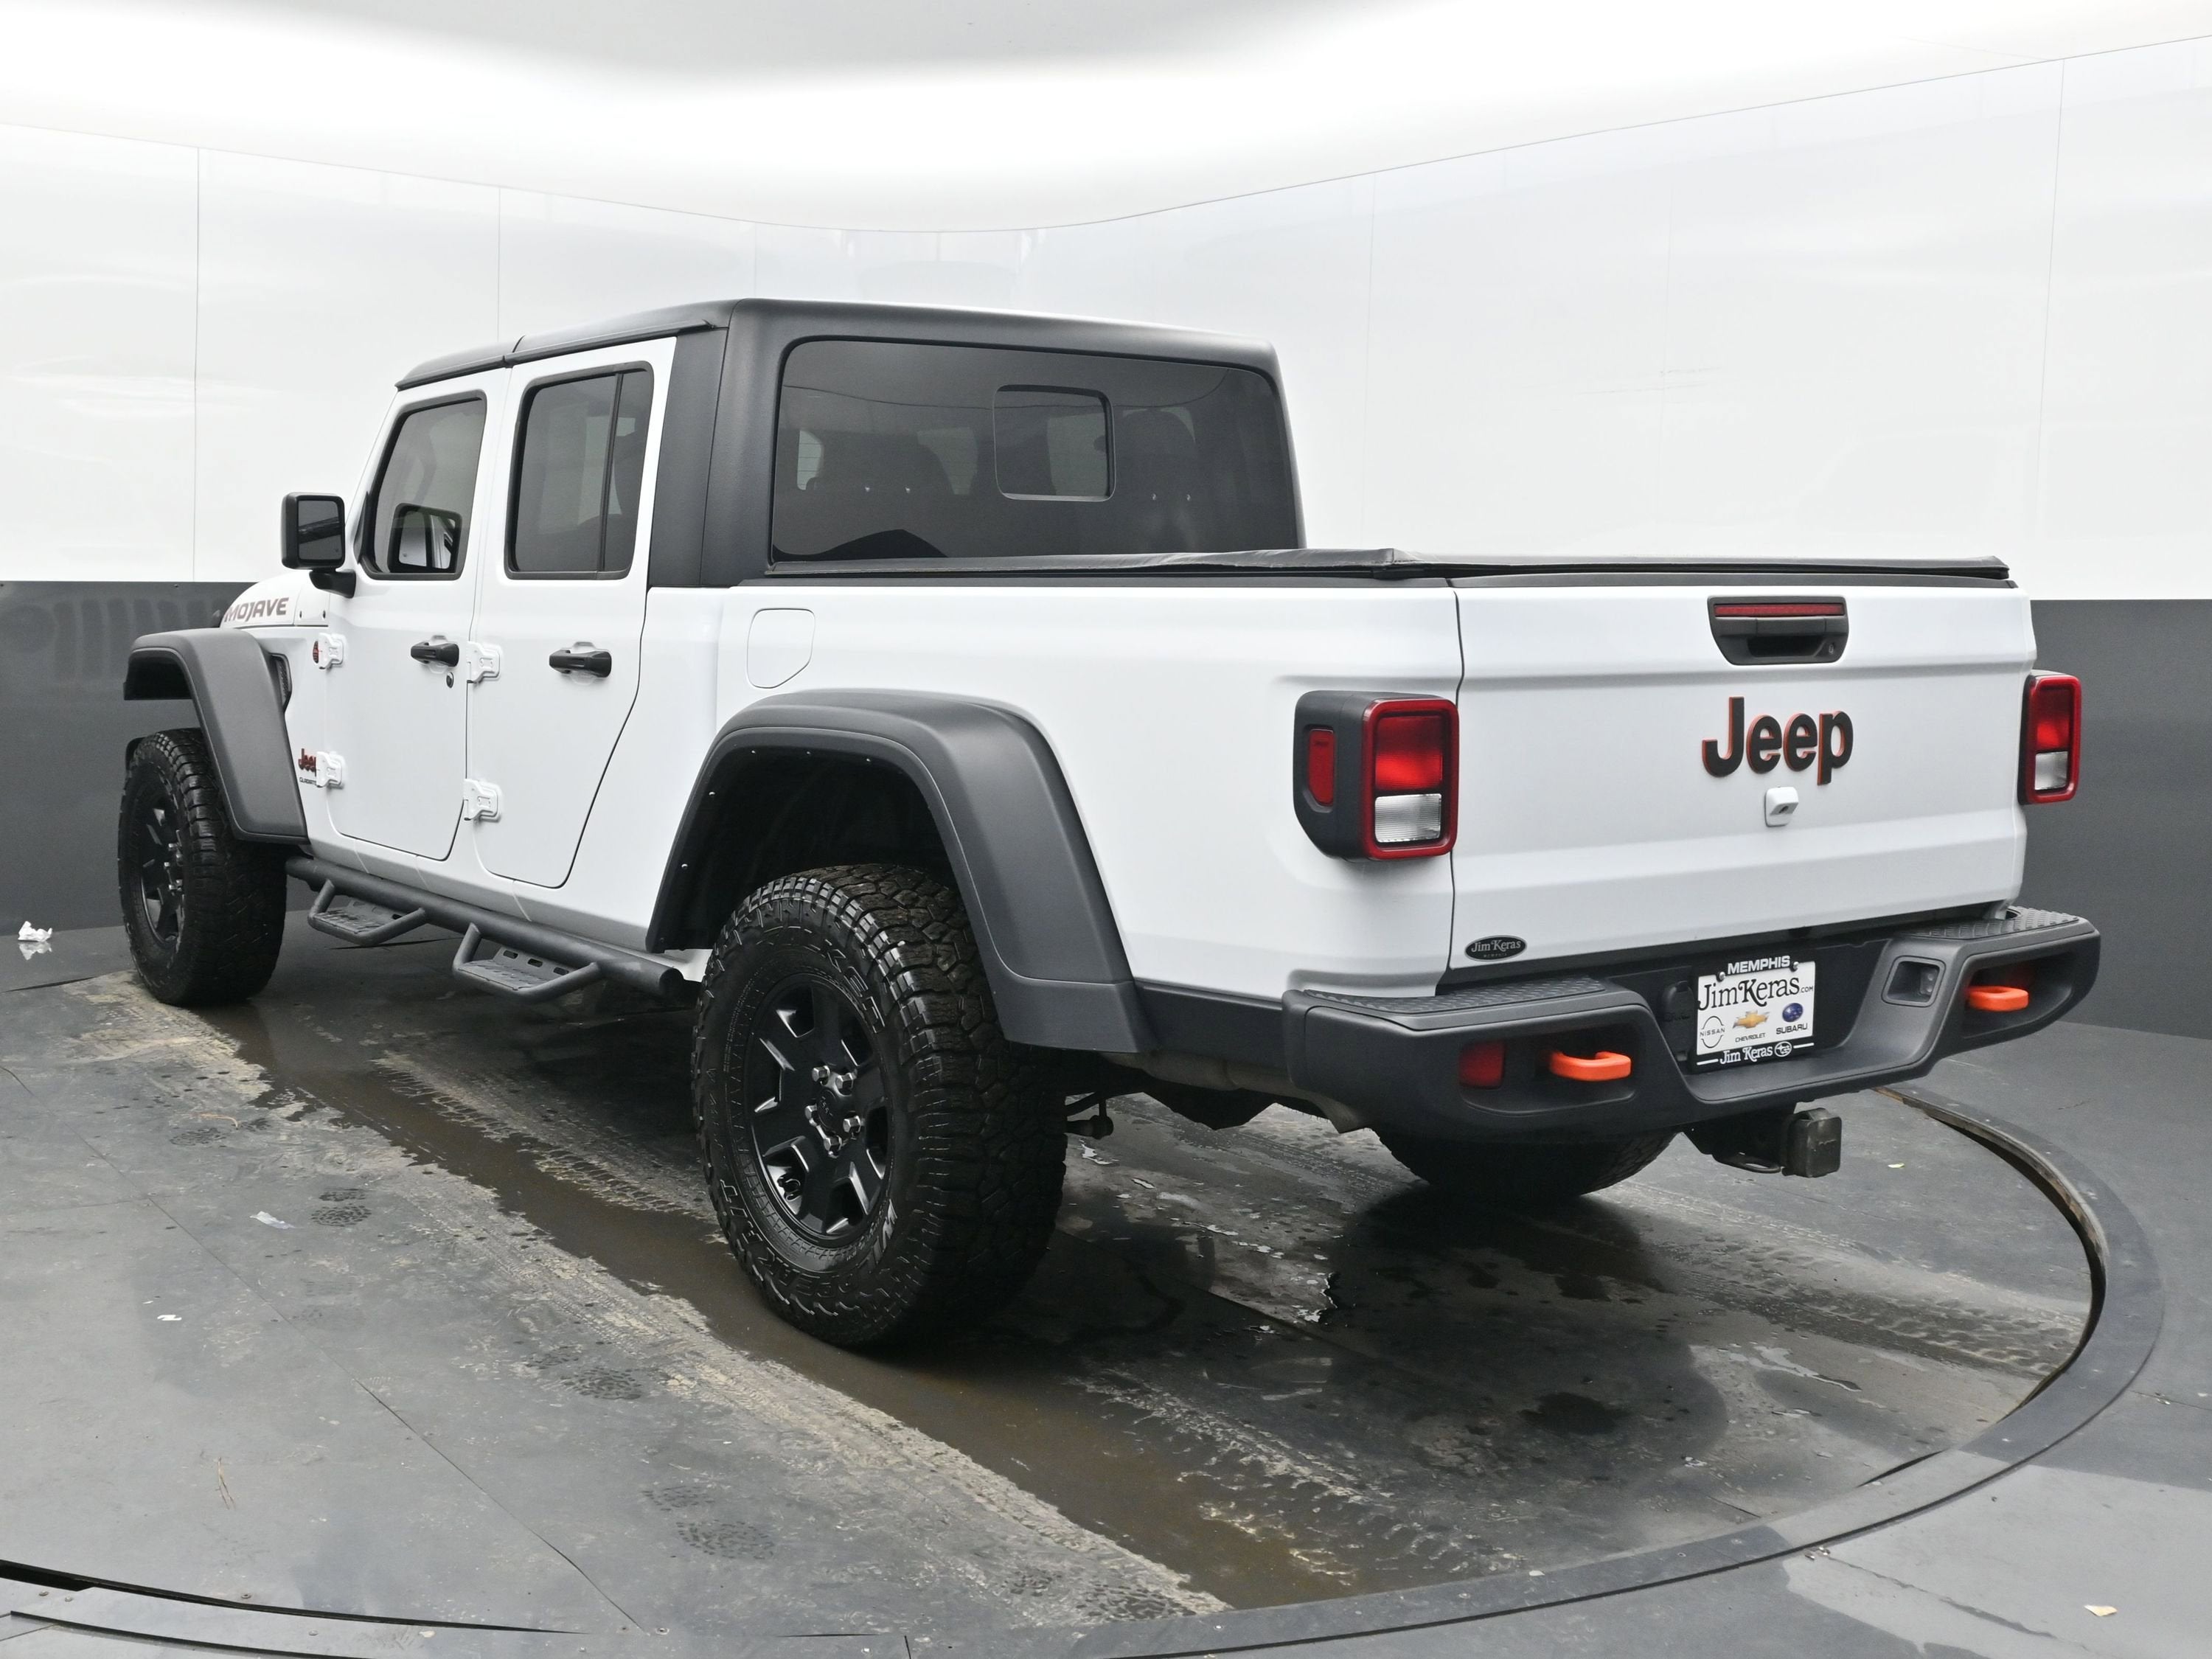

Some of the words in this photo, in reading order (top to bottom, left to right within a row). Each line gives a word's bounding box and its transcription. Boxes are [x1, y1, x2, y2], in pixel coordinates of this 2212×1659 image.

[224, 597, 290, 622] MOJAVE
[1702, 696, 1854, 786] Jeep
[1471, 942, 1490, 953] Jim
[1491, 939, 1521, 952] Keras
[1728, 956, 1790, 974] MEMPHIS
[1700, 1027, 1725, 1037] NISSAN
[1775, 1023, 1808, 1035] SUBARU
[1735, 1033, 1766, 1043] CHEVROLET
[1719, 1050, 1741, 1065] Jim
[1742, 1046, 1773, 1062] Keras
